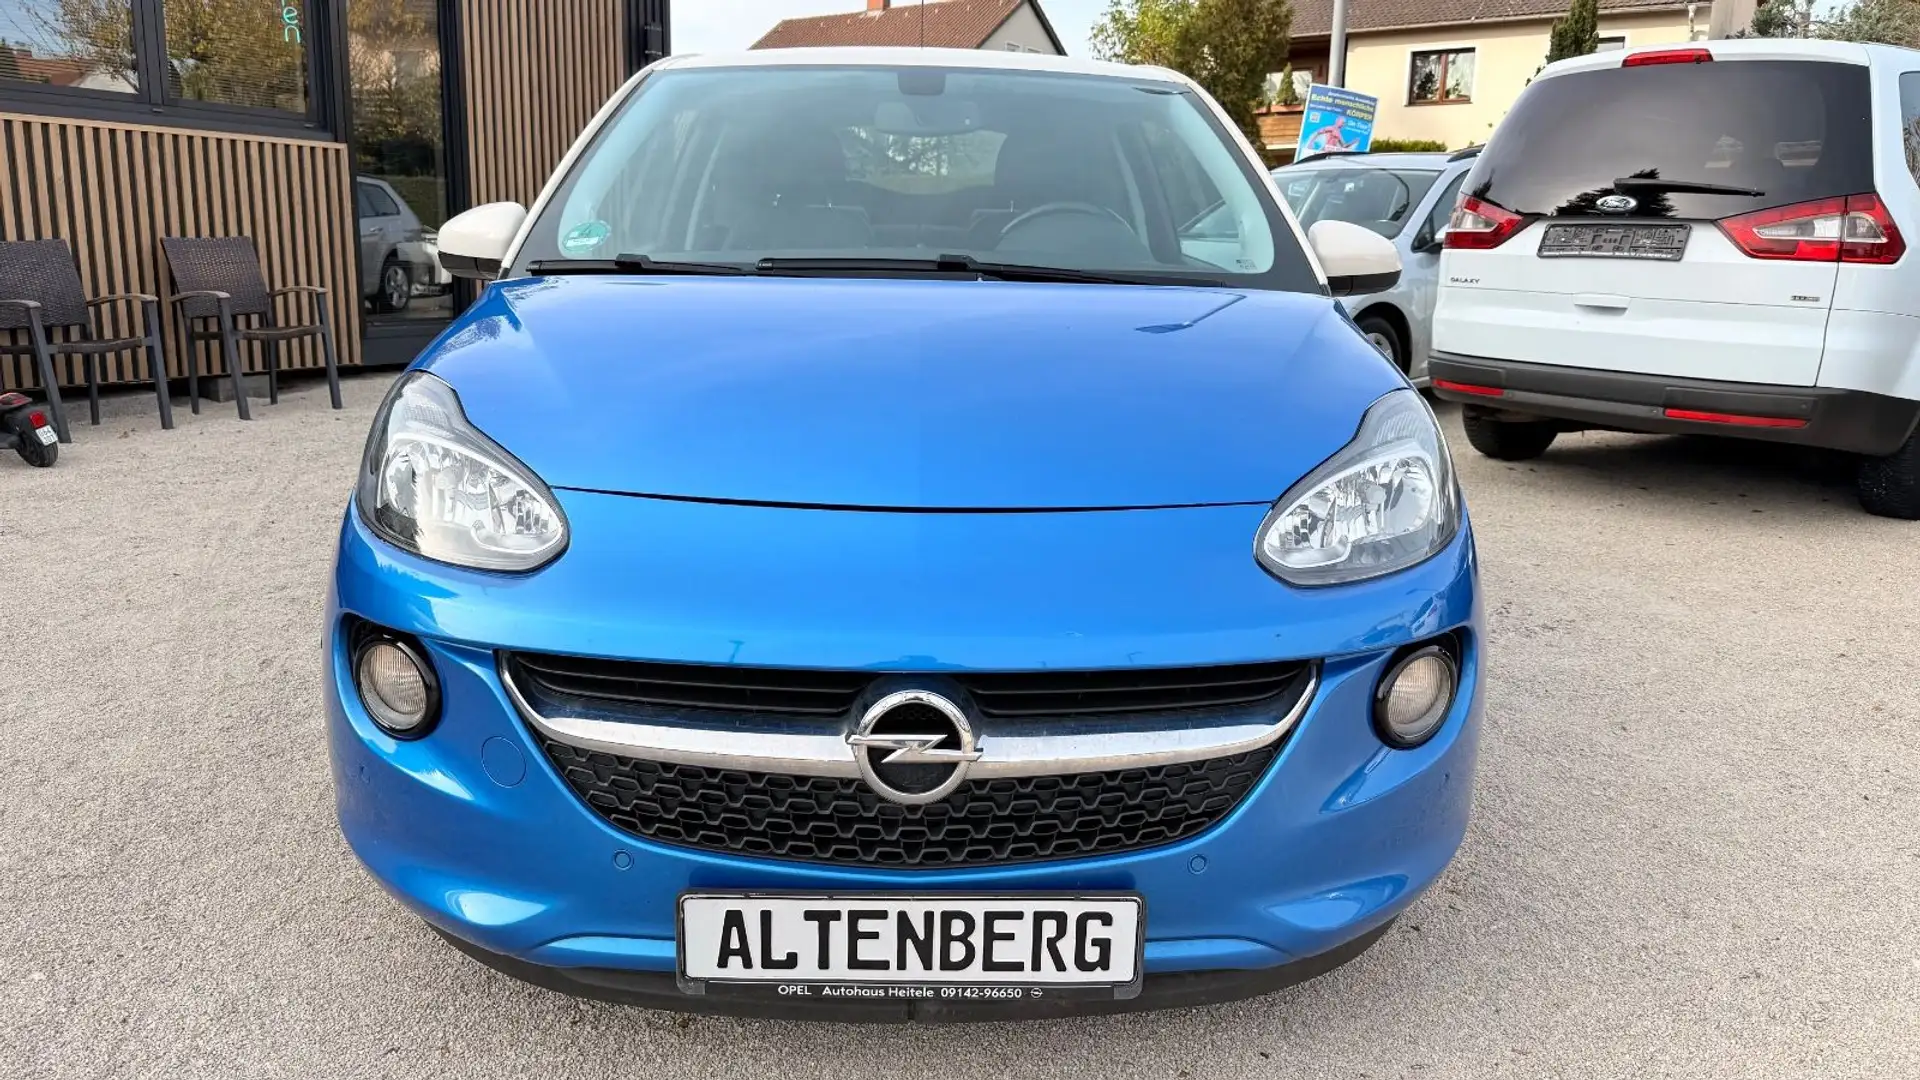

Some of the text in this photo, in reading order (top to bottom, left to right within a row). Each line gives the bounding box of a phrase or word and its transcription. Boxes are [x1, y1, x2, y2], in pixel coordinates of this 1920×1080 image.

[716, 909, 1113, 972] ALTENBERG
[778, 985, 1023, 999] OPEL Autohaus Heitele 09142-96650
